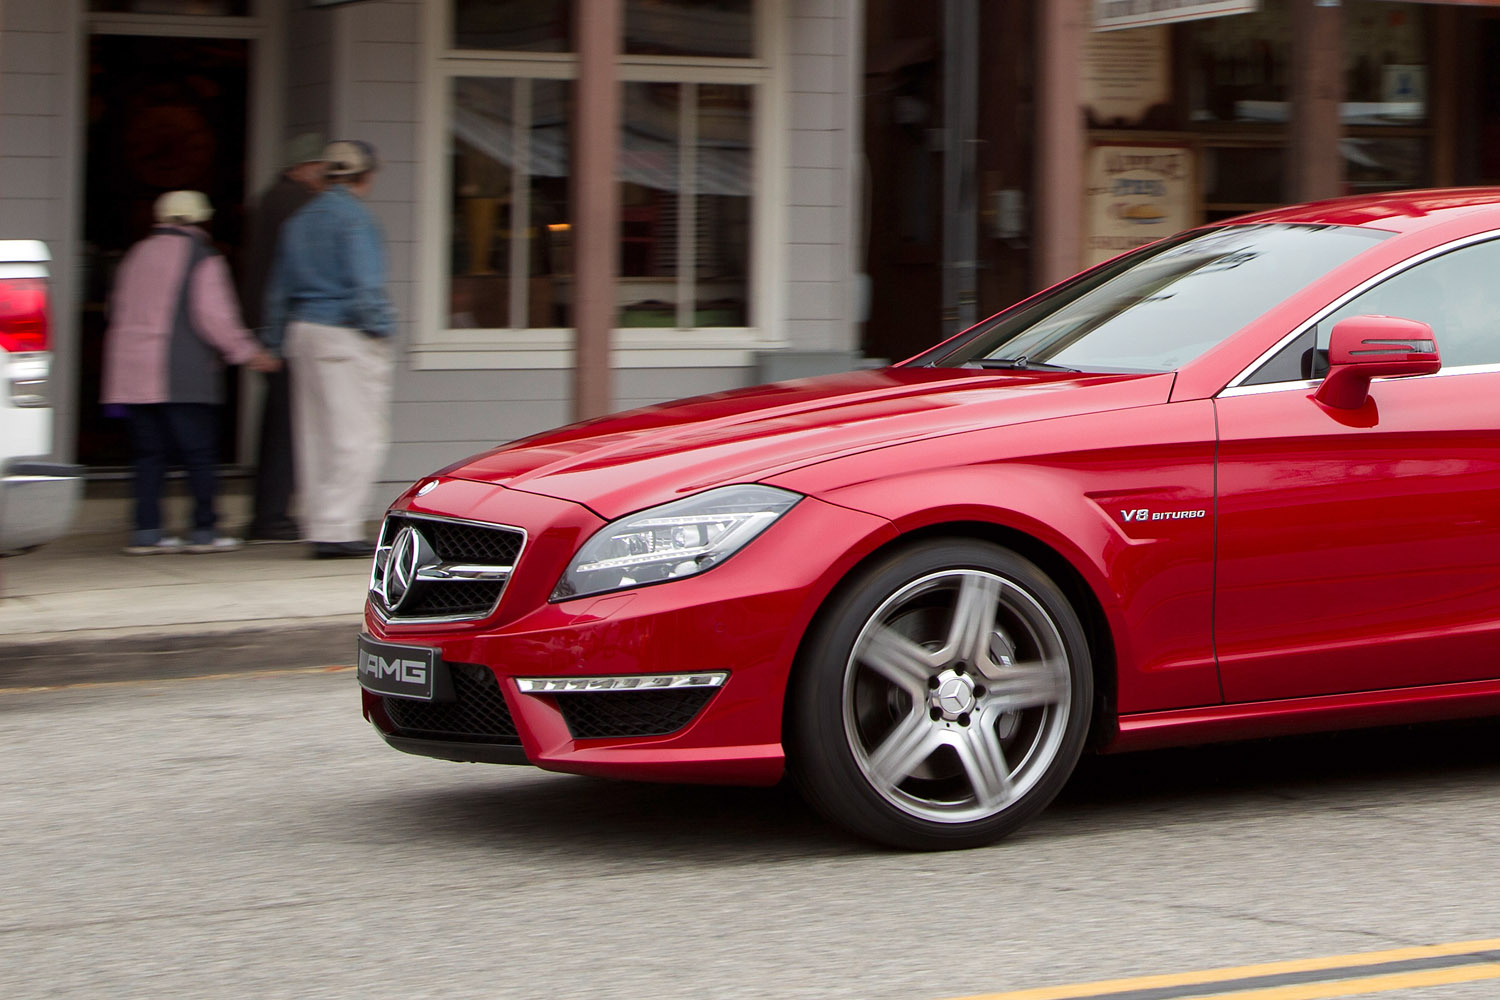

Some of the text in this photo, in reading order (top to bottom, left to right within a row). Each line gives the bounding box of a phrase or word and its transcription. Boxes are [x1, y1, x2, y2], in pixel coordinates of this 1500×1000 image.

[1120, 508, 1206, 522] V8 BITURBO
[365, 653, 427, 685] AMG
